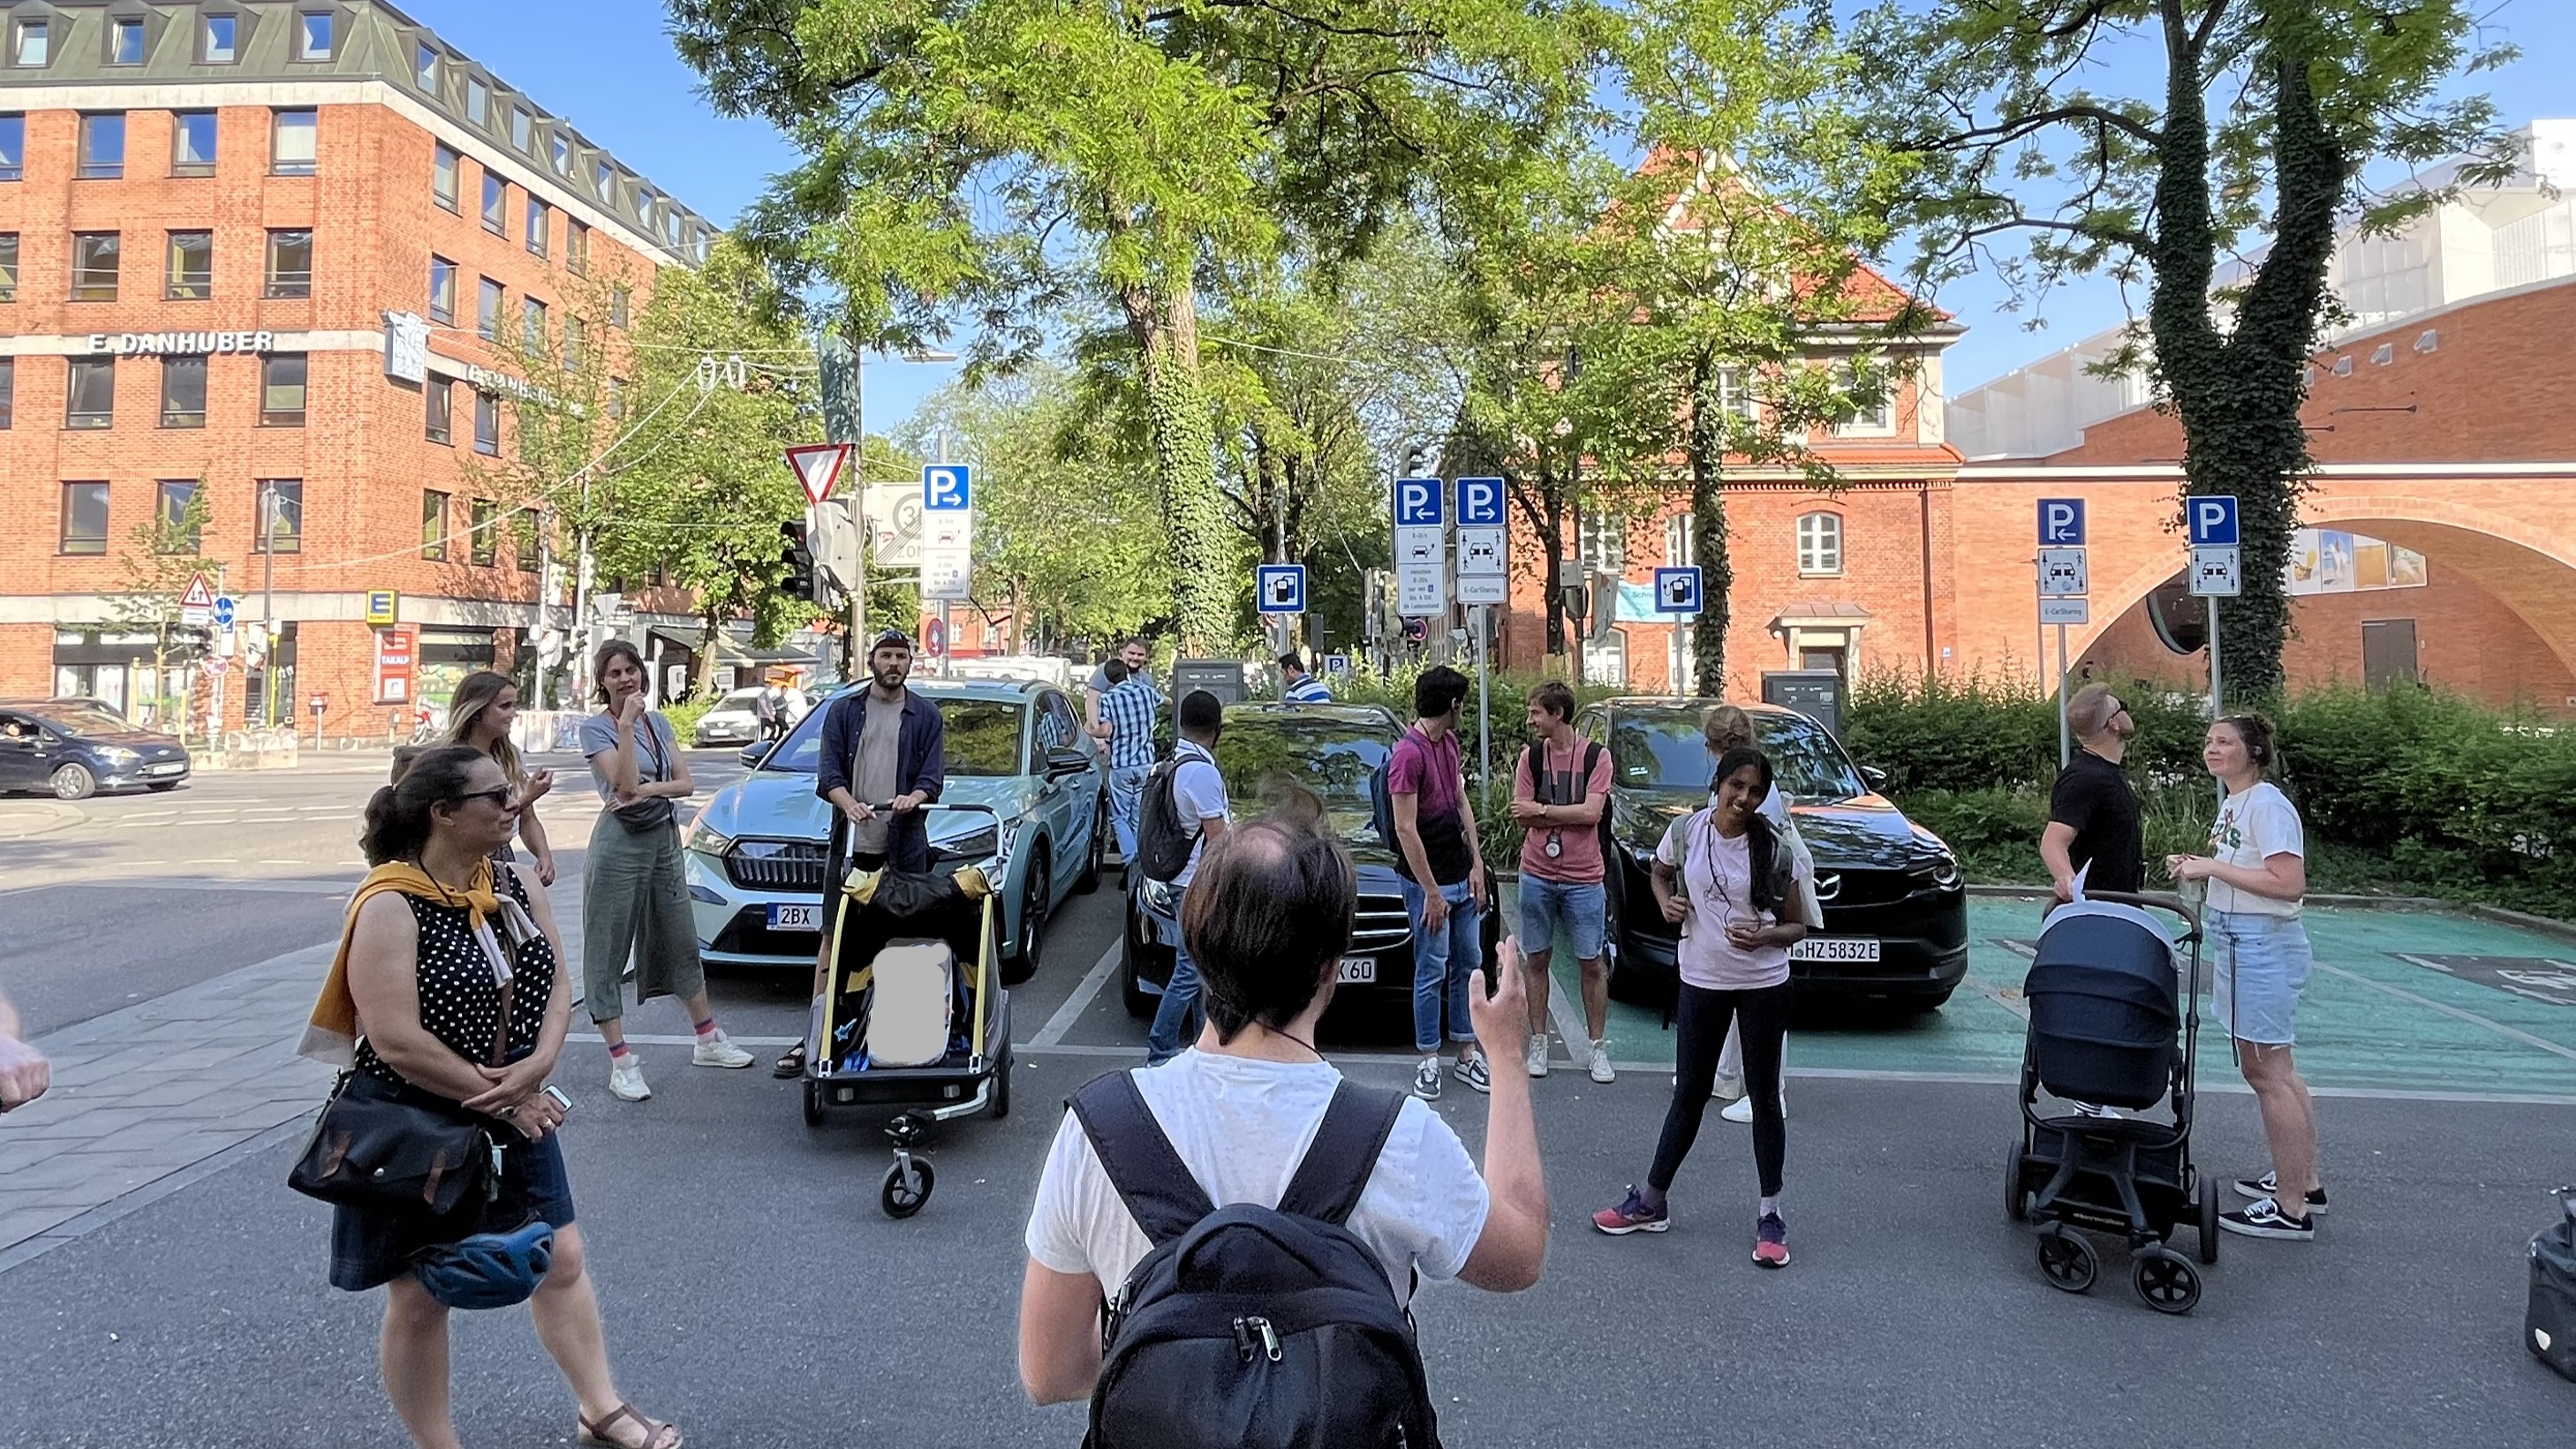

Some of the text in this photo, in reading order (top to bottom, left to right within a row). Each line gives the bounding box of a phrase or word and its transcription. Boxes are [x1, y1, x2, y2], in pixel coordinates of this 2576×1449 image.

[121, 330, 273, 353] DANHUBER
[931, 470, 956, 506] P
[1403, 485, 1429, 520] P
[1468, 484, 1493, 519] P
[2049, 504, 2074, 540] P
[2199, 503, 2225, 539] P
[781, 908, 811, 924] 2BX
[1805, 941, 1825, 958] HZ
[1349, 961, 1372, 979] 60
